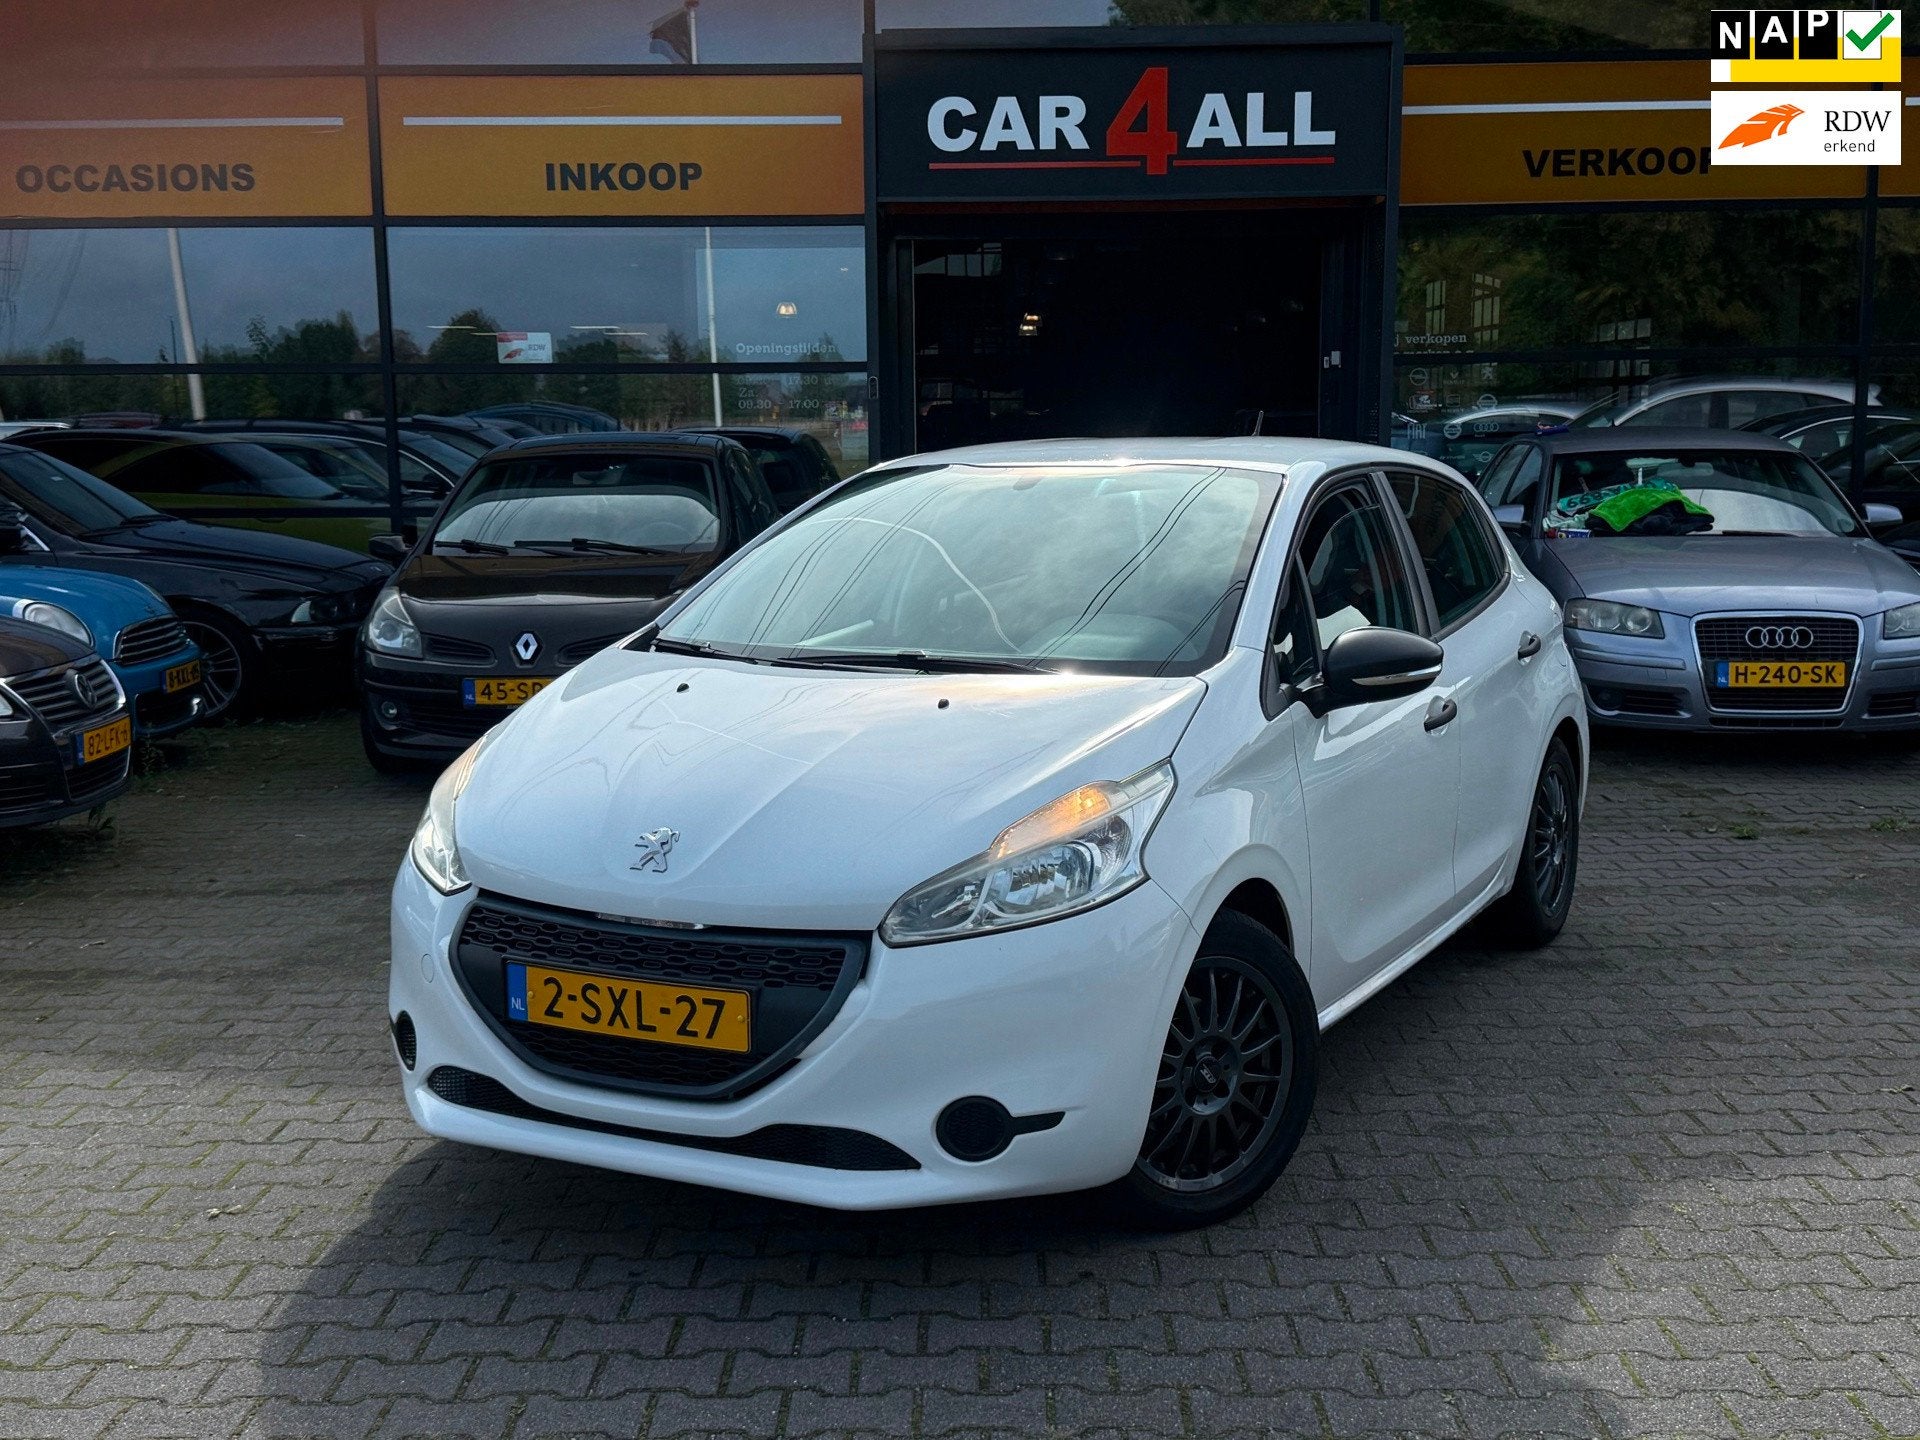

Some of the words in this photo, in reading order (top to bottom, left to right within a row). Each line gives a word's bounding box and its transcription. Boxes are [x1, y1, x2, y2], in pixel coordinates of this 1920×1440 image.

[926, 94, 1091, 153] CAR
[1105, 66, 1179, 176] 4
[1186, 90, 1337, 149] ALL
[15, 163, 257, 193] OCCASIONS
[545, 162, 703, 191] INKOOP
[735, 342, 837, 355] Openingstijden
[1405, 333, 1467, 346] verkopen
[1735, 665, 1838, 684] H-240-SK
[511, 996, 526, 1012] NL
[543, 976, 727, 1040] 2-SXL-27
